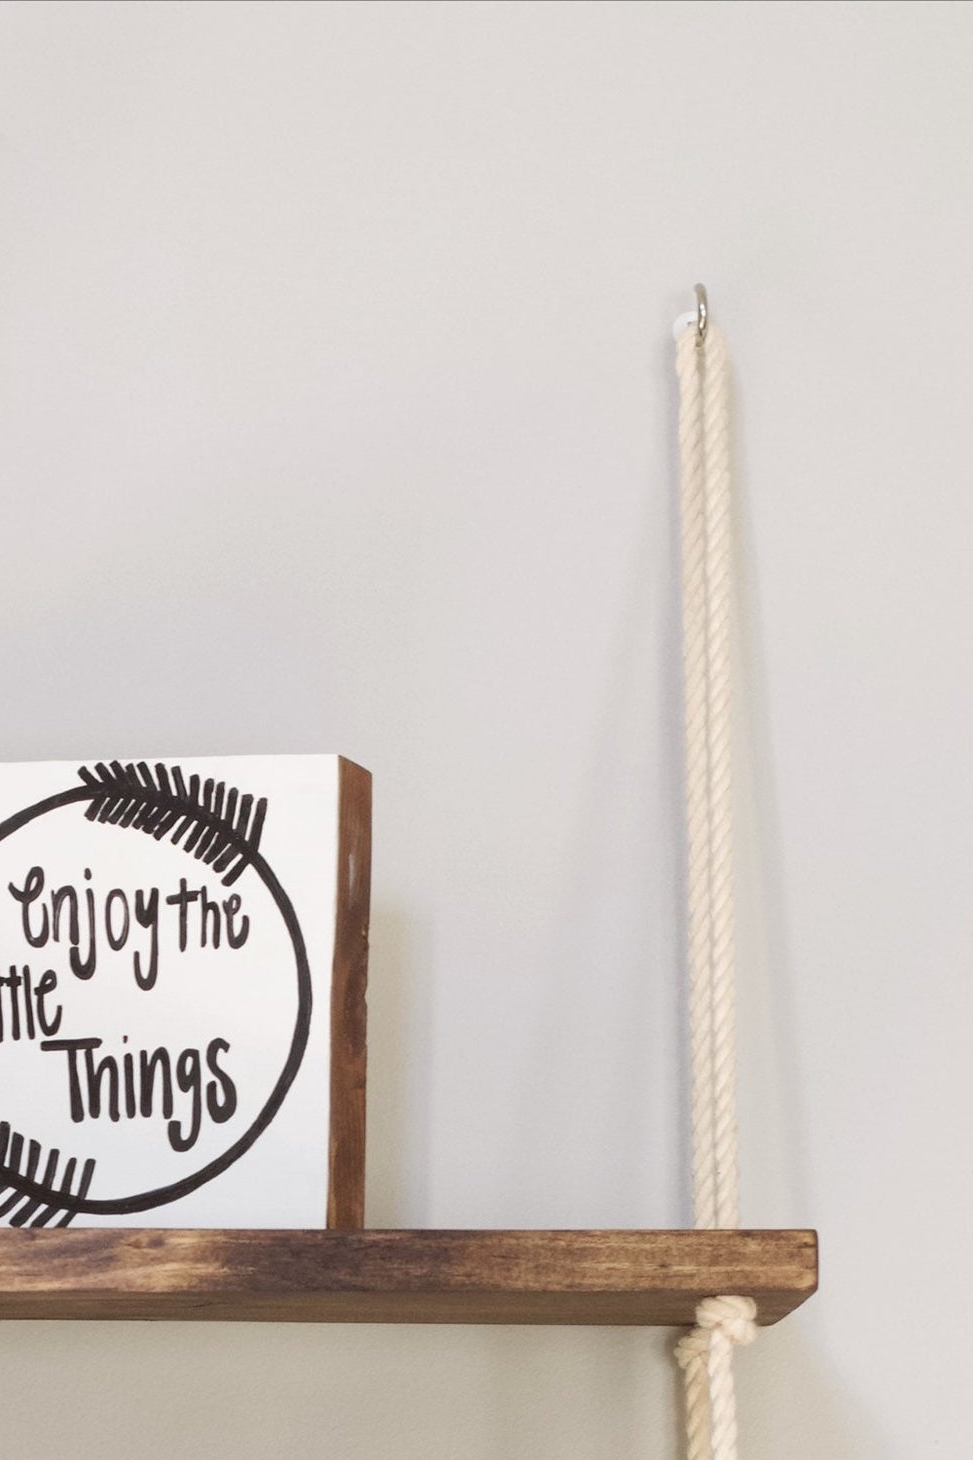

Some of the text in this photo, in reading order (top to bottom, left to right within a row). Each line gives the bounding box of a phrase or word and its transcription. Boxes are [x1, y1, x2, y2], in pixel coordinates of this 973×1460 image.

[8, 866, 250, 991] enjoy the
[41, 1035, 237, 1152] Things
